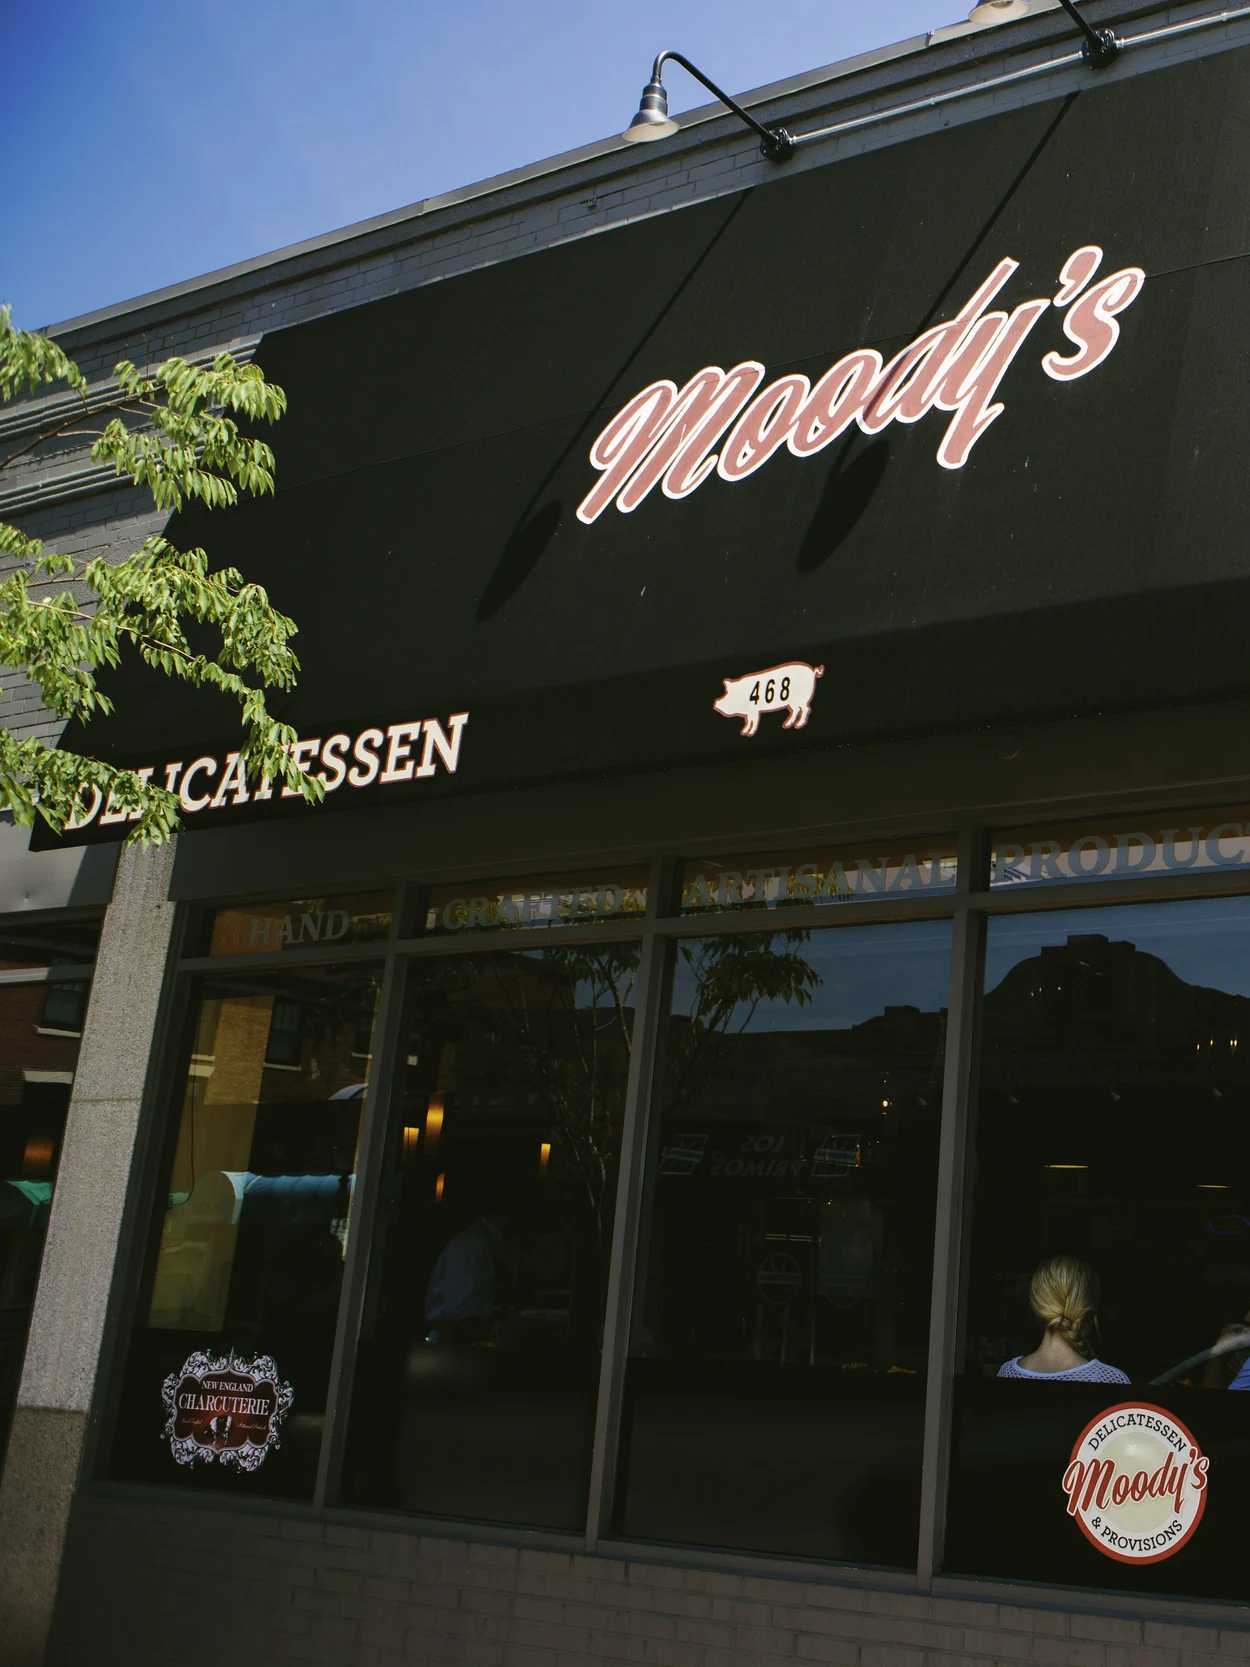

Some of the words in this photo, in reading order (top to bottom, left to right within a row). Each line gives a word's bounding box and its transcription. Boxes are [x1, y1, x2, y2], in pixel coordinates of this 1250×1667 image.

[575, 245, 1146, 524] Moody's
[749, 677, 792, 705] 468
[249, 909, 350, 949] HAND
[442, 882, 624, 932] CRAFTED
[686, 852, 956, 908] ARTISANAL
[178, 1393, 270, 1416] CHARCUTERIE
[202, 1381, 218, 1390] NEW
[219, 1382, 254, 1393] ENGLAND
[1088, 1413, 1187, 1452] DELICATESSEN
[1062, 1446, 1210, 1516] Moody's
[1092, 1516, 1102, 1529] &
[1101, 1519, 1183, 1552] PROVISIONS
